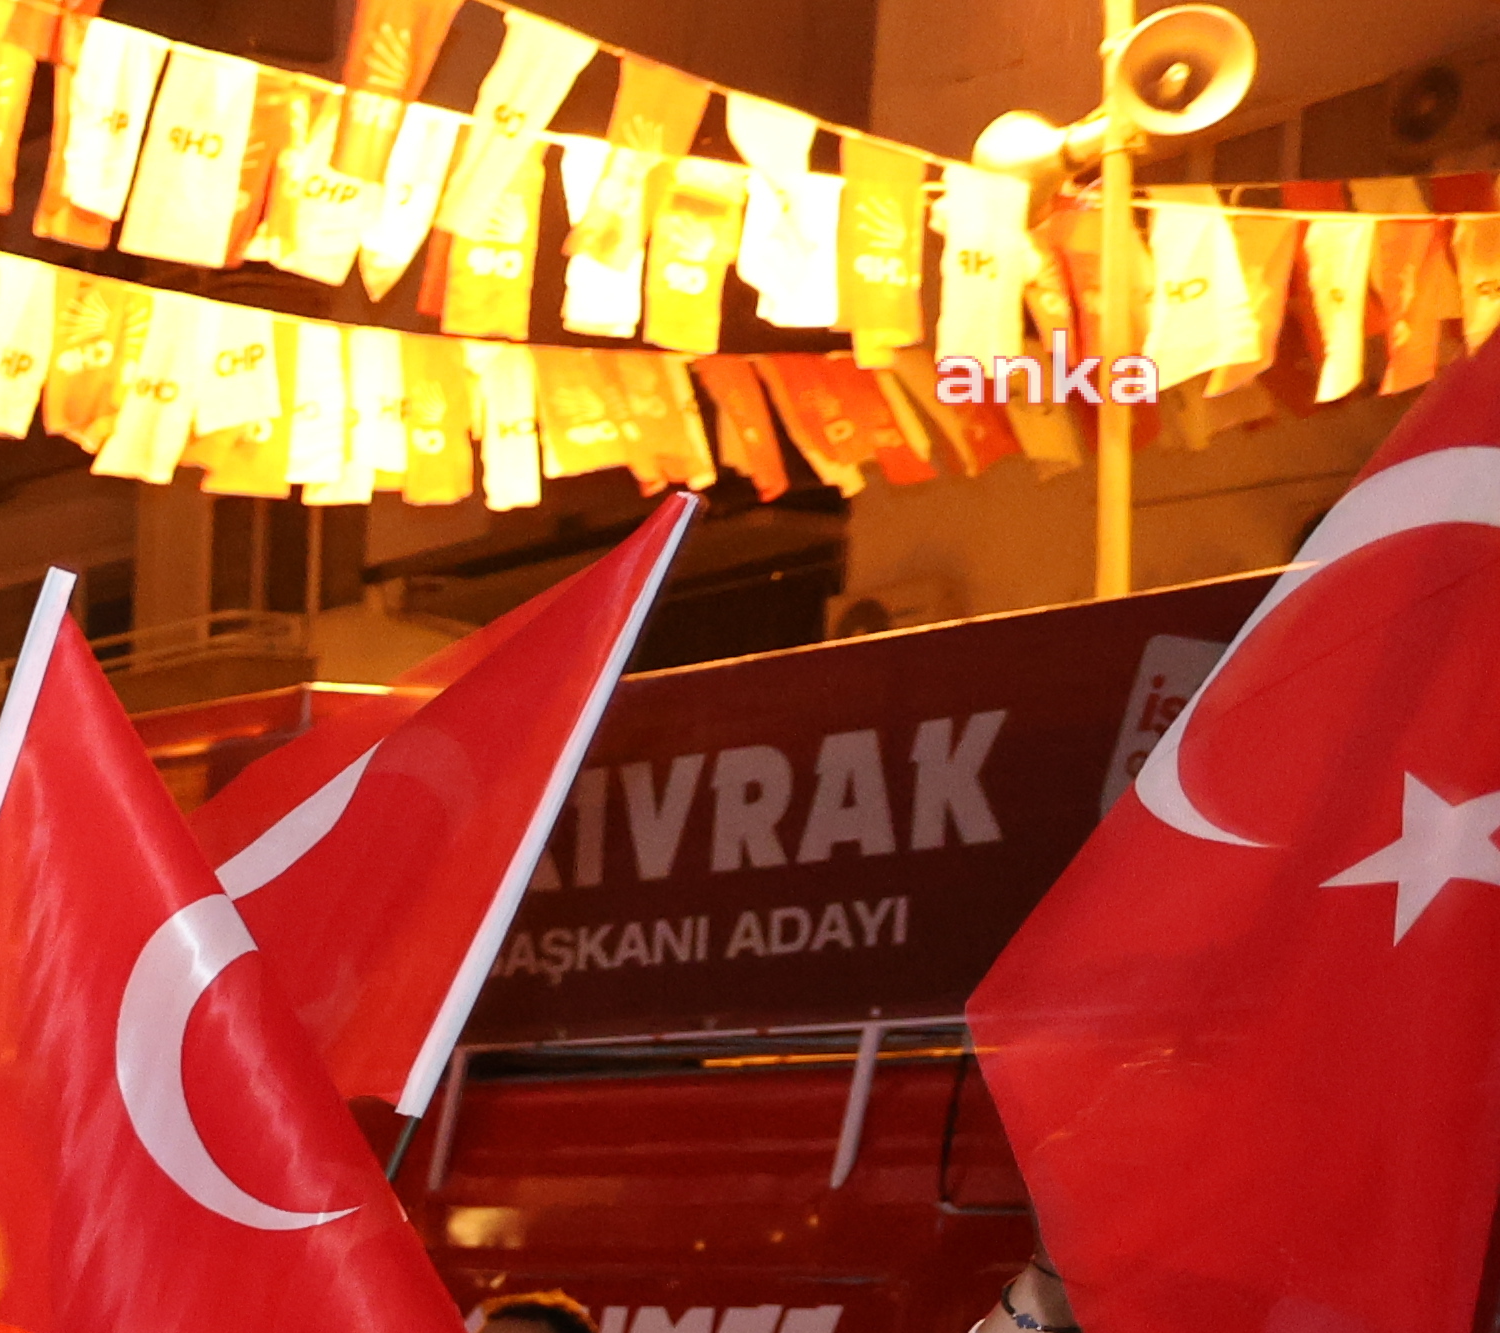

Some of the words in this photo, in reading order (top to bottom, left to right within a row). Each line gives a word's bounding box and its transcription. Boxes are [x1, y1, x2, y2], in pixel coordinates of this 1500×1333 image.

[303, 174, 359, 204] CHP
[492, 915, 712, 986] AŞKANI
[724, 896, 911, 959] ADAYI
